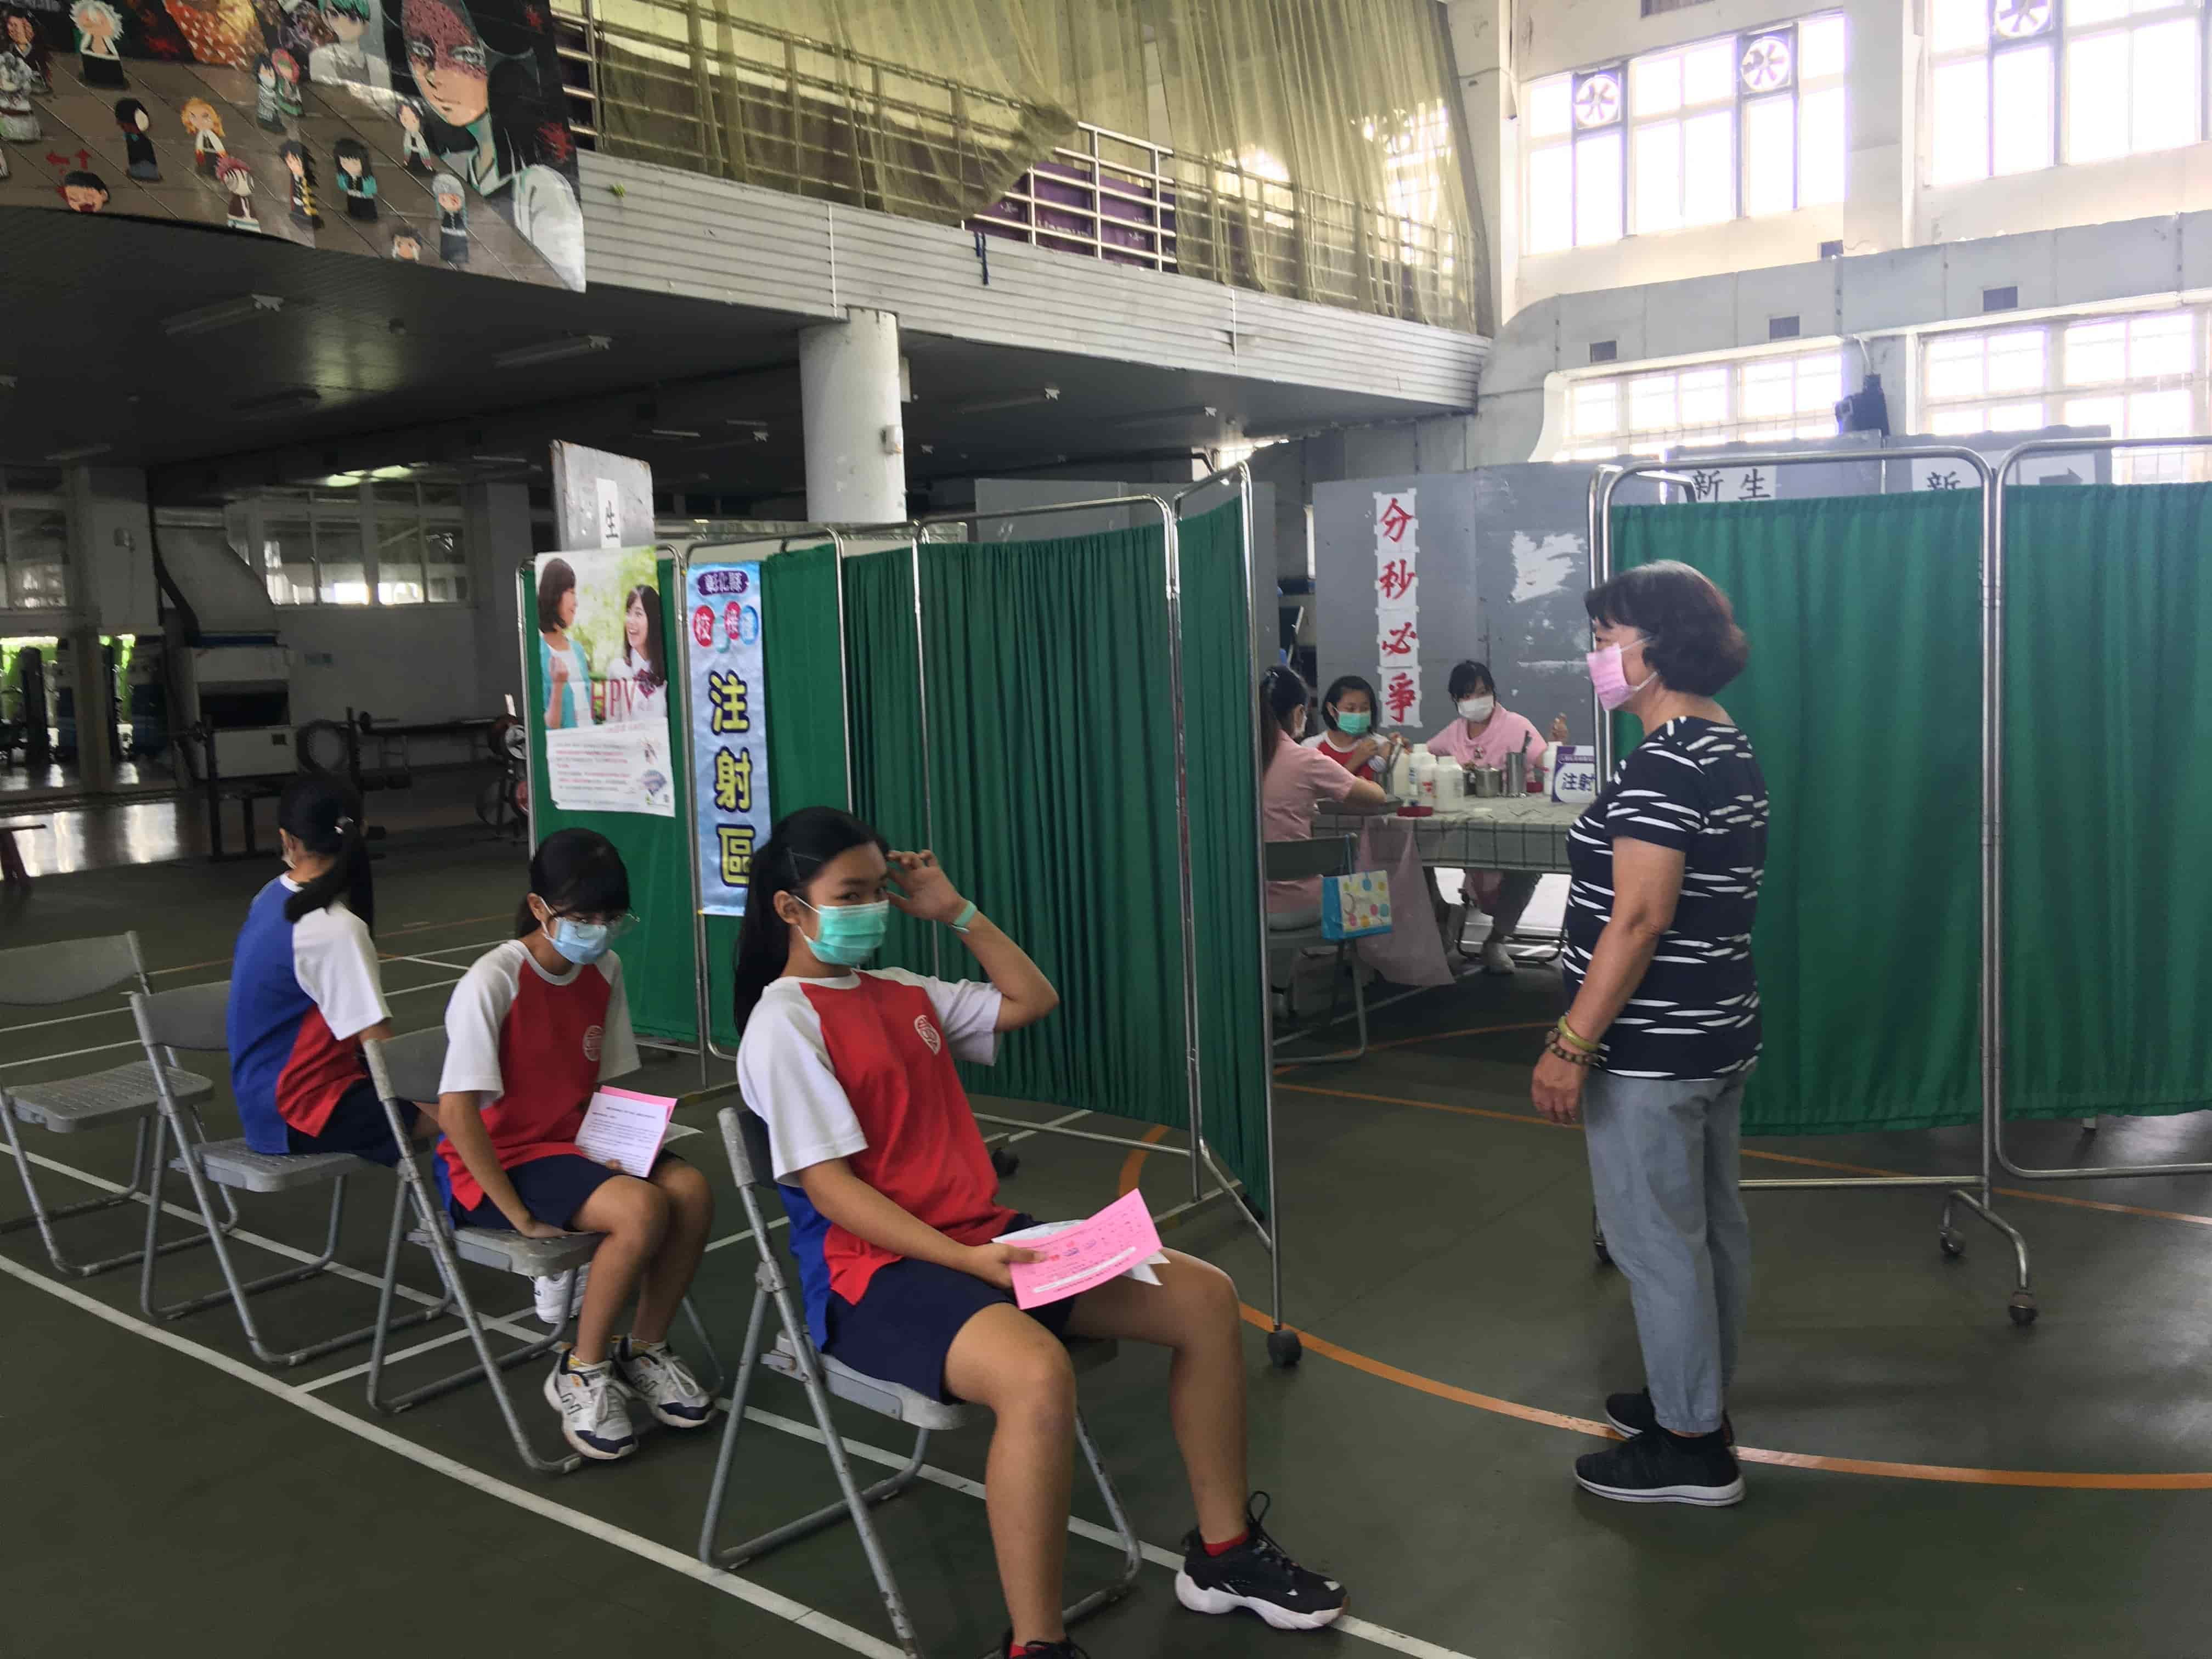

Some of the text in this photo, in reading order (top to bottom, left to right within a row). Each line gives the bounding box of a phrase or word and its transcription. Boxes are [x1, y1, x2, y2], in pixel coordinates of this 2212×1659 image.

[590, 676, 637, 721] HPV
[1379, 498, 1417, 723] 分秒必爭
[708, 670, 756, 887] 注射區
